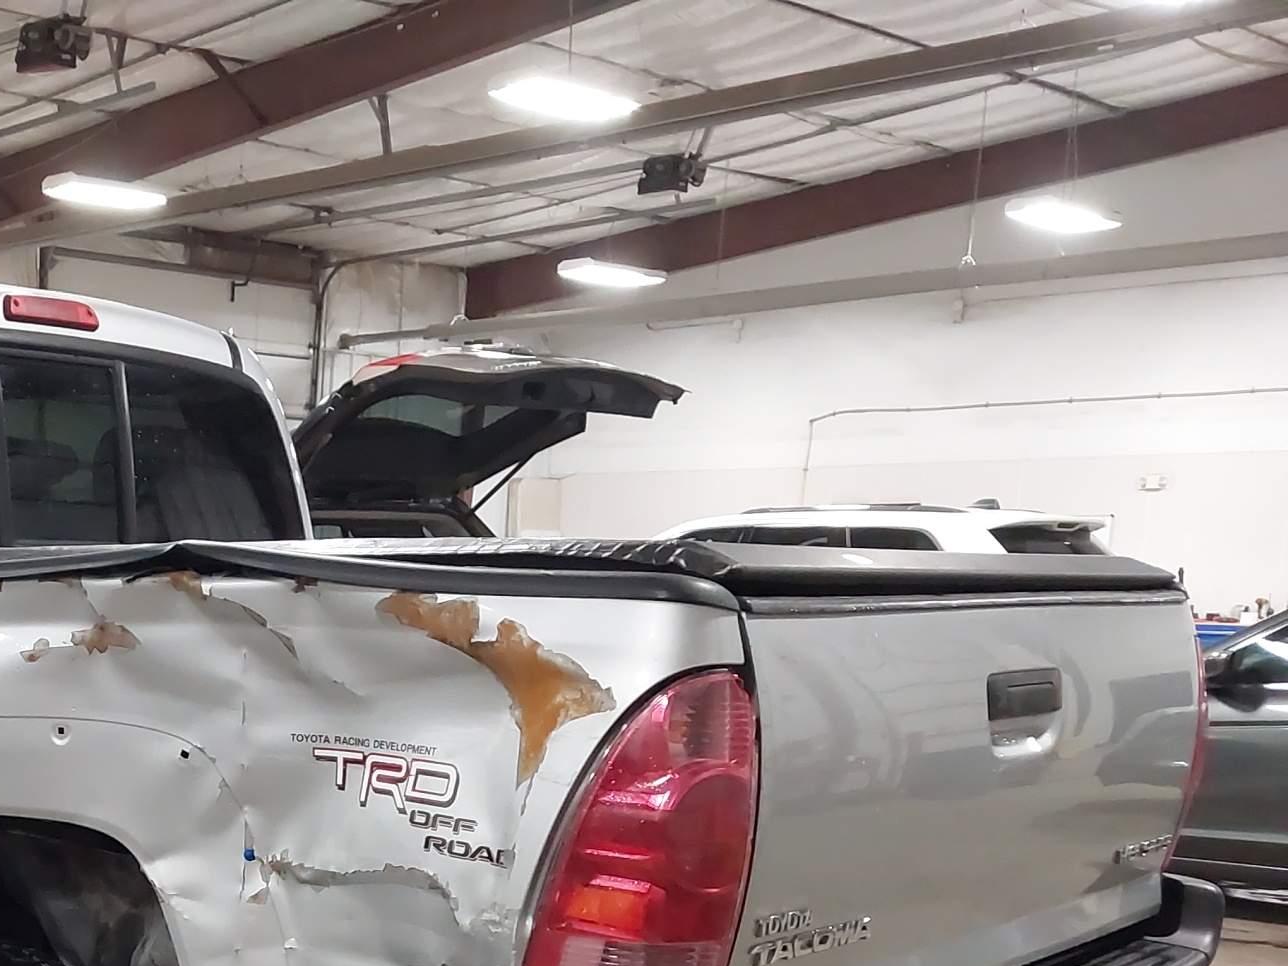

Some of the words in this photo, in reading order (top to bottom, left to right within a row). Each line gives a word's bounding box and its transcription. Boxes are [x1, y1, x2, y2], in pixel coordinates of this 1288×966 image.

[291, 733, 330, 744] TOYOTA
[334, 736, 370, 748] RACING
[373, 739, 437, 756] DEVELOPMENT
[312, 747, 460, 815] TRD
[409, 809, 478, 834] OFF
[748, 917, 871, 966] TACOMA
